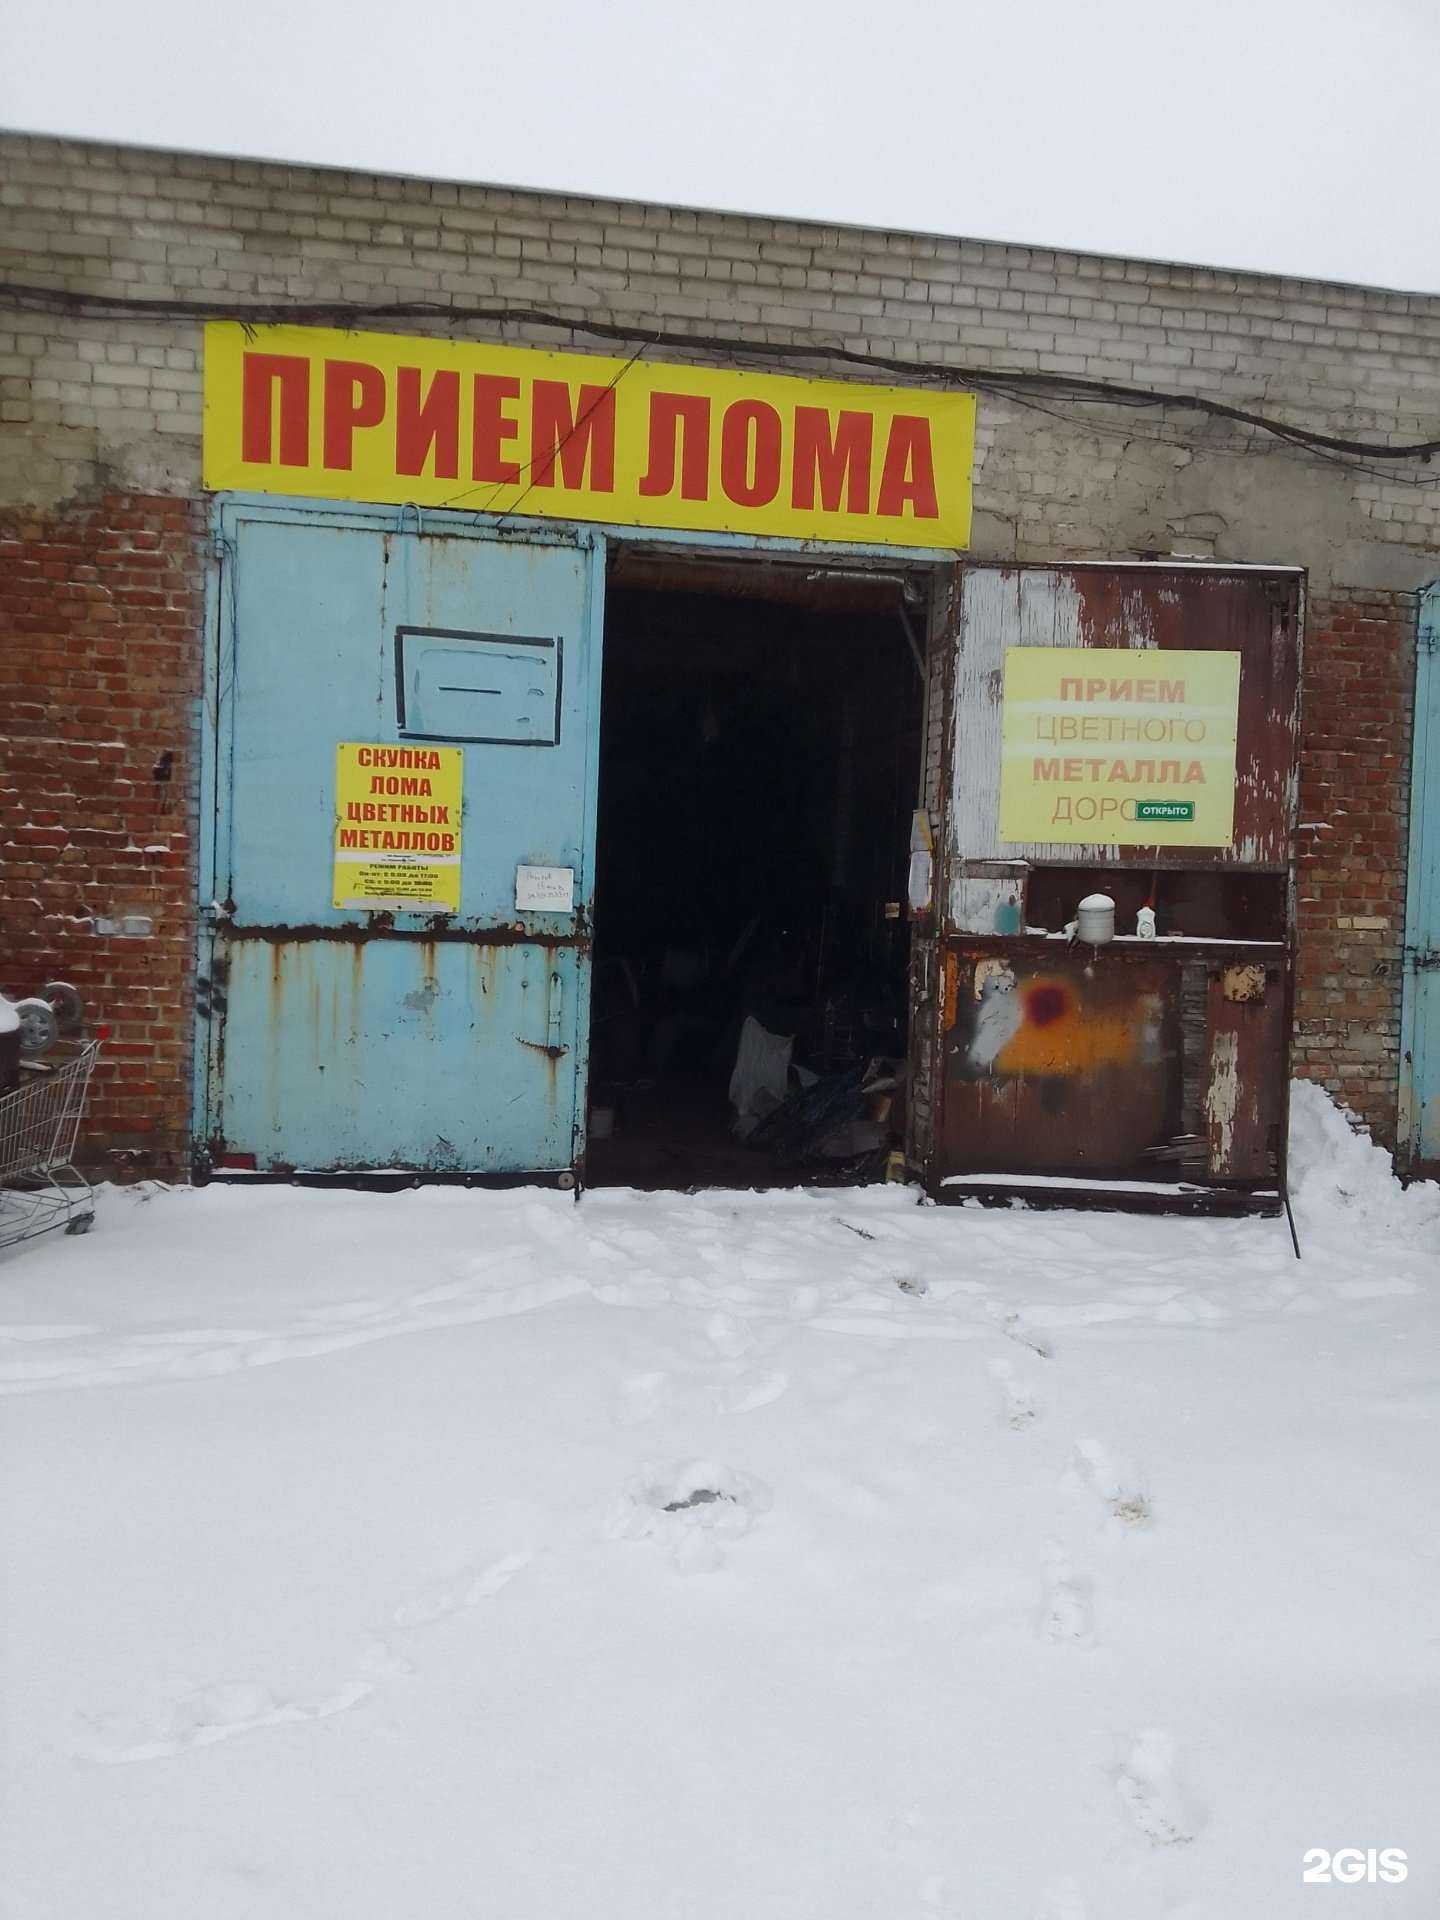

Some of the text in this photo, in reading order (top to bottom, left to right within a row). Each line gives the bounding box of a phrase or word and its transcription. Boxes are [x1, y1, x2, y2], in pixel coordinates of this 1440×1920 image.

[242, 351, 939, 519] ПРИЕМ ЛОМА
[1060, 677, 1185, 703] ПРИЕМ
[1036, 715, 1206, 745] ЦВЕТНОГО
[358, 748, 441, 770] СКУПКА
[1033, 758, 1206, 784] МЕТАЛЛА
[369, 776, 432, 797] ЛОМА
[347, 802, 449, 825] ЦВЕТНЫХ
[1052, 797, 1177, 825] ДОРО
[1142, 806, 1189, 816] ОТКРЫТО
[340, 829, 455, 851] МЕТАЛЛОВ
